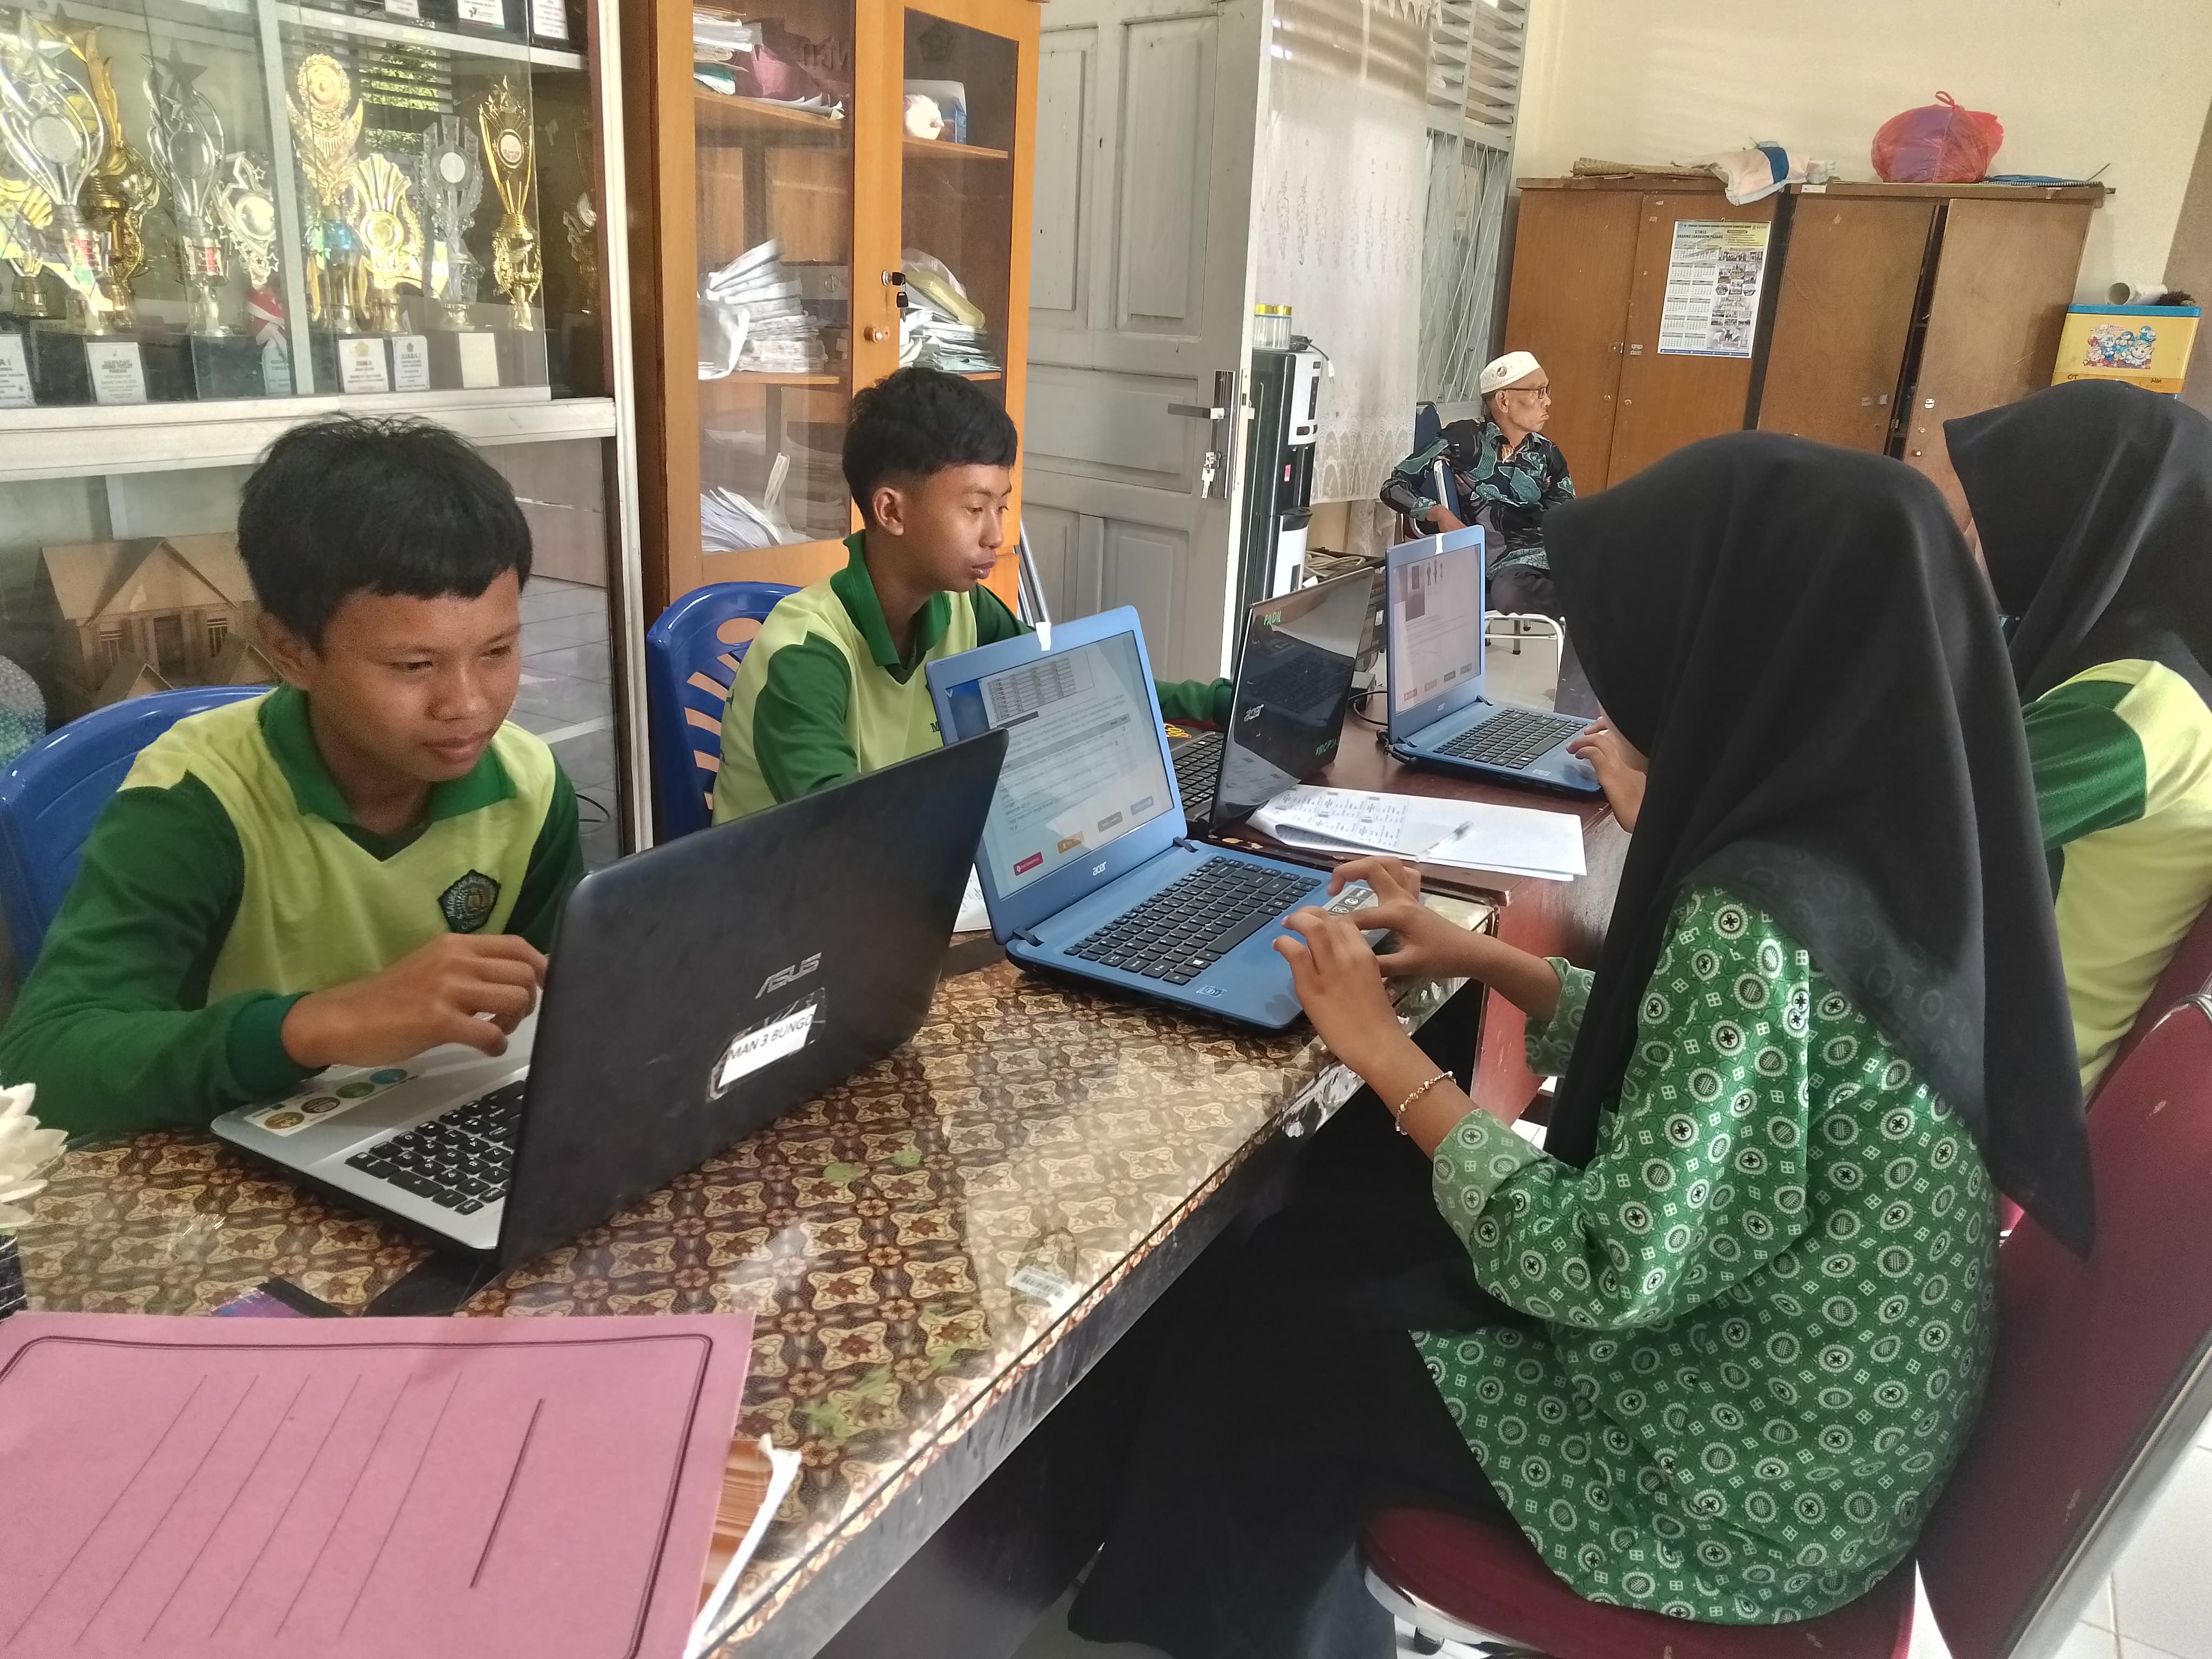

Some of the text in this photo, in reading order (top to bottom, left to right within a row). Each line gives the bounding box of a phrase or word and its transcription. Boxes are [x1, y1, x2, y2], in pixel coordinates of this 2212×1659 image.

[1092, 861, 1107, 876] acer
[755, 952, 822, 999] ASUS
[727, 1037, 759, 1061] MAN
[760, 1034, 768, 1047] 3
